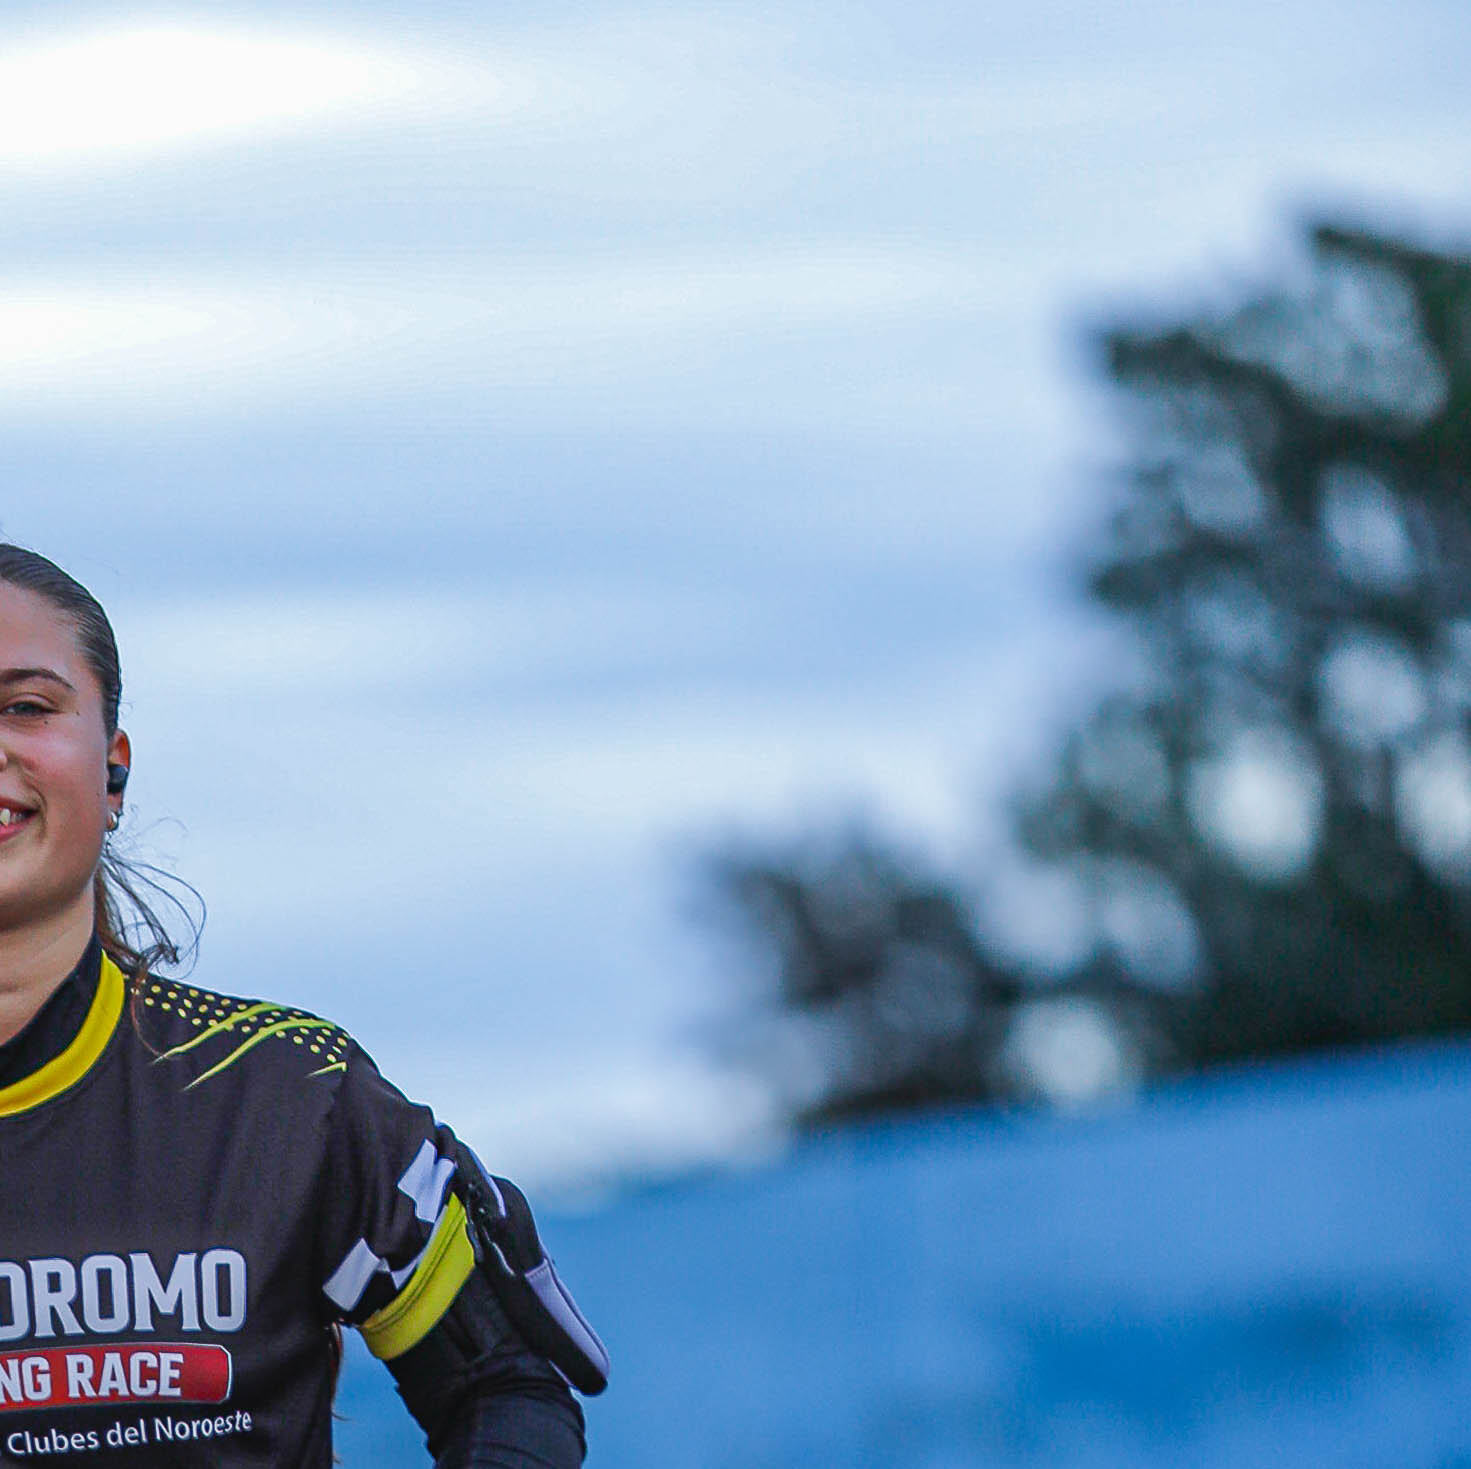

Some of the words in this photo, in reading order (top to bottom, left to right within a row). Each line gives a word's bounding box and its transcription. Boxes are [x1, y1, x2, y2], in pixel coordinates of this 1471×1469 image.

[65, 1351, 185, 1399] RACE
[7, 1428, 100, 1455] Clubes
[106, 1418, 148, 1447] del
[153, 1409, 253, 1442] Noroeste
